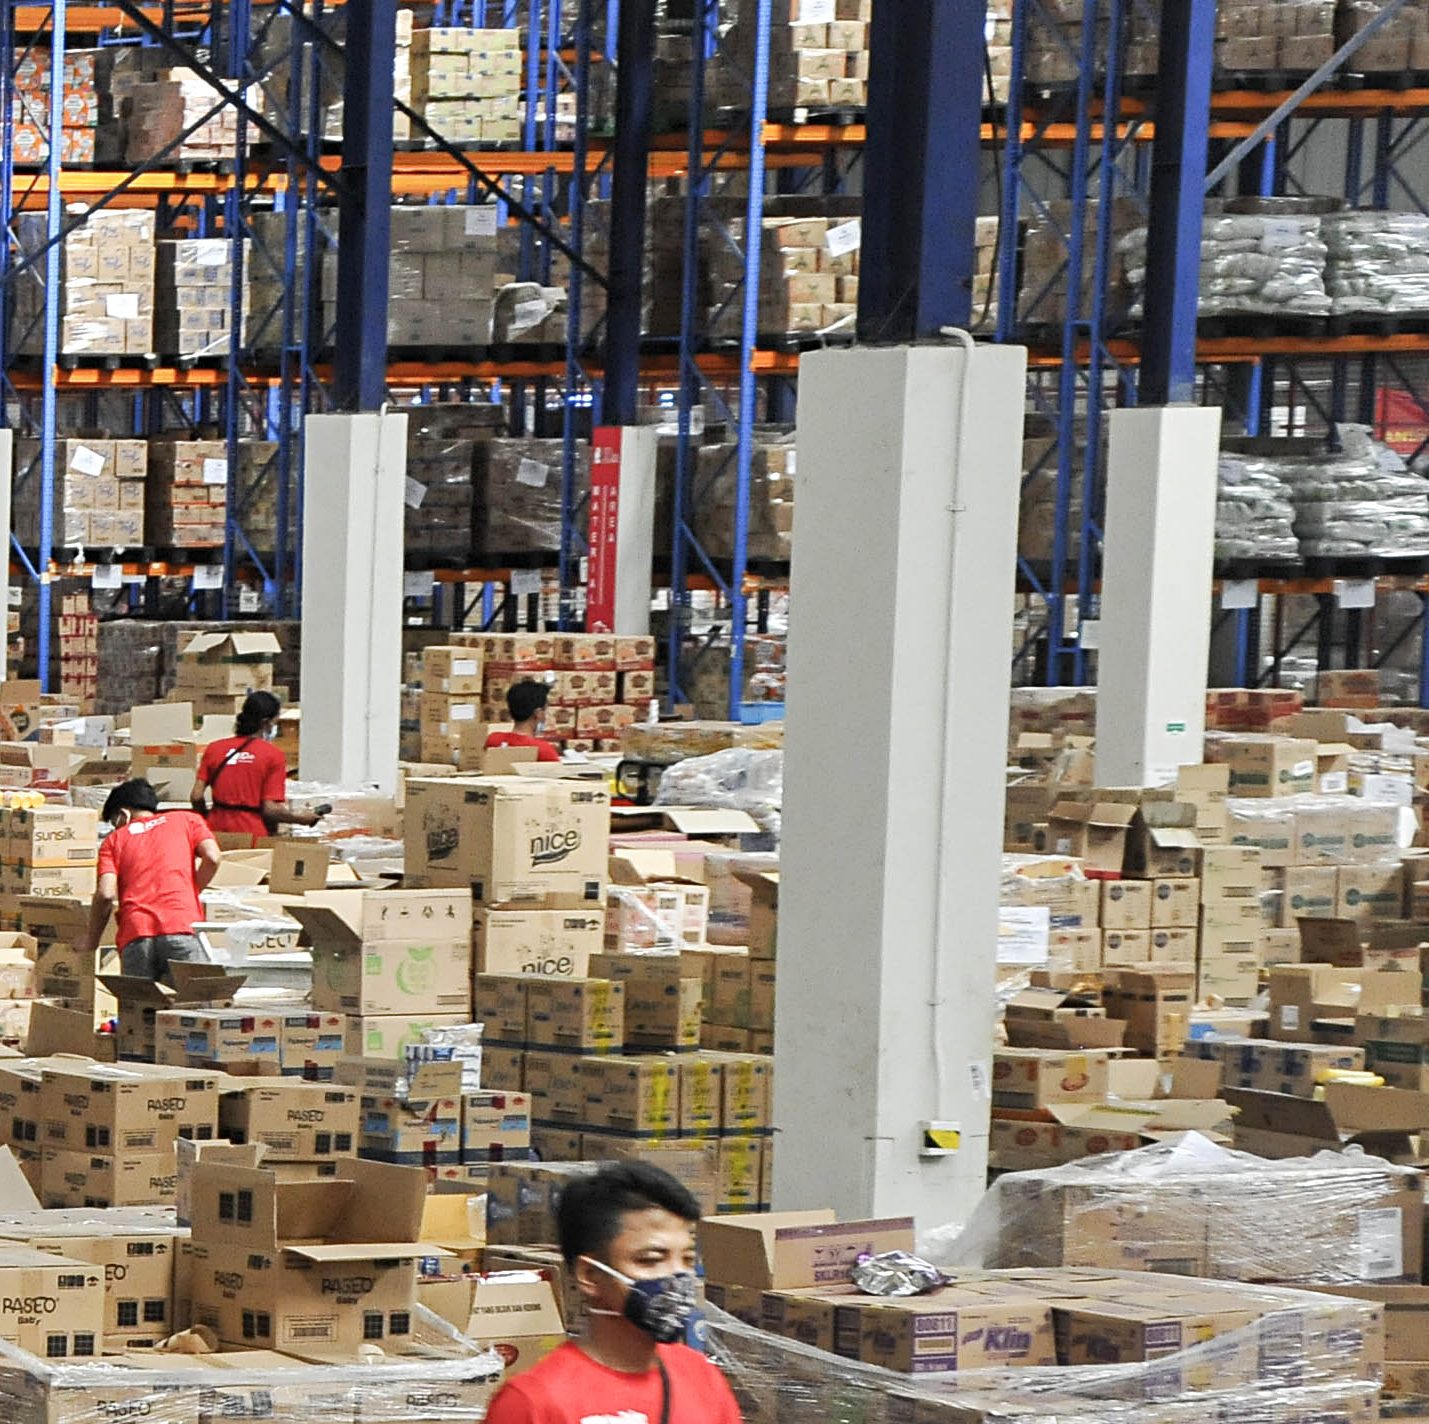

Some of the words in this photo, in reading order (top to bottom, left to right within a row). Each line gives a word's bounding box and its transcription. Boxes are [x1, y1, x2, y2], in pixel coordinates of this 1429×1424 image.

[35, 828, 76, 842] sunsilk
[529, 828, 580, 854] nice
[147, 1097, 186, 1112] PASEO
[287, 1109, 325, 1123] PASEO
[321, 1277, 375, 1294] PASEO
[2, 1296, 58, 1315] PASEO
